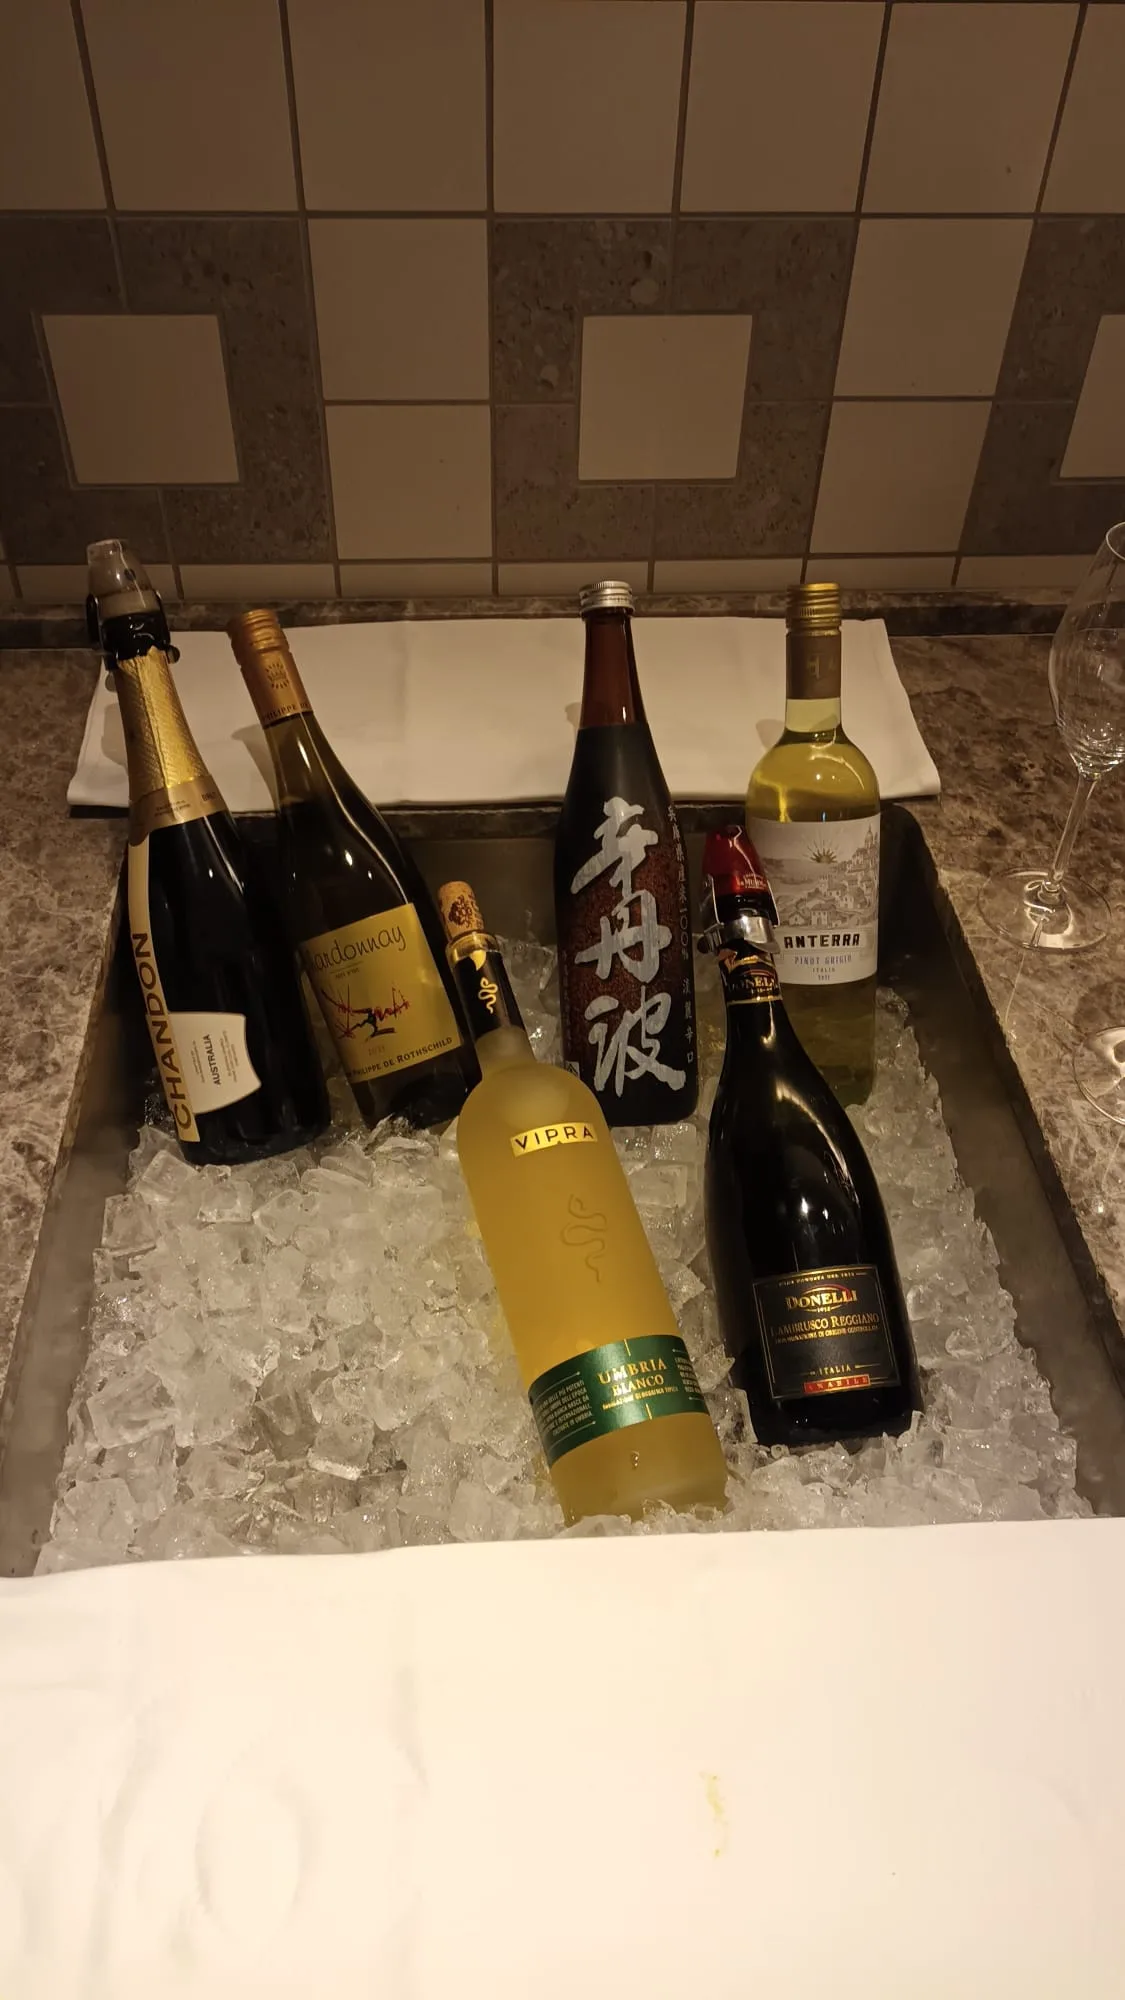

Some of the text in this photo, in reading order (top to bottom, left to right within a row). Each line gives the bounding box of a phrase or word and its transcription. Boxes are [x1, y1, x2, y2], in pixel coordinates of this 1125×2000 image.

[302, 926, 406, 971] ardonnay
[571, 797, 686, 1096] 辛丹波
[784, 933, 860, 949] ANTERRA
[795, 956, 820, 964] PINOT
[132, 933, 192, 1130] CHANDON
[203, 1034, 221, 1085] AUSTRALIA
[384, 1059, 394, 1068] DE
[397, 1037, 453, 1064] ROTHSCHILD
[515, 1126, 593, 1150] VIPRA
[785, 1290, 858, 1310] DONELLI
[770, 1313, 880, 1336] LAMBRUSCO REGGIANO
[598, 1358, 667, 1385] UMBRIA
[819, 1365, 851, 1376] ITALIA
[612, 1374, 664, 1396] BIANCO
